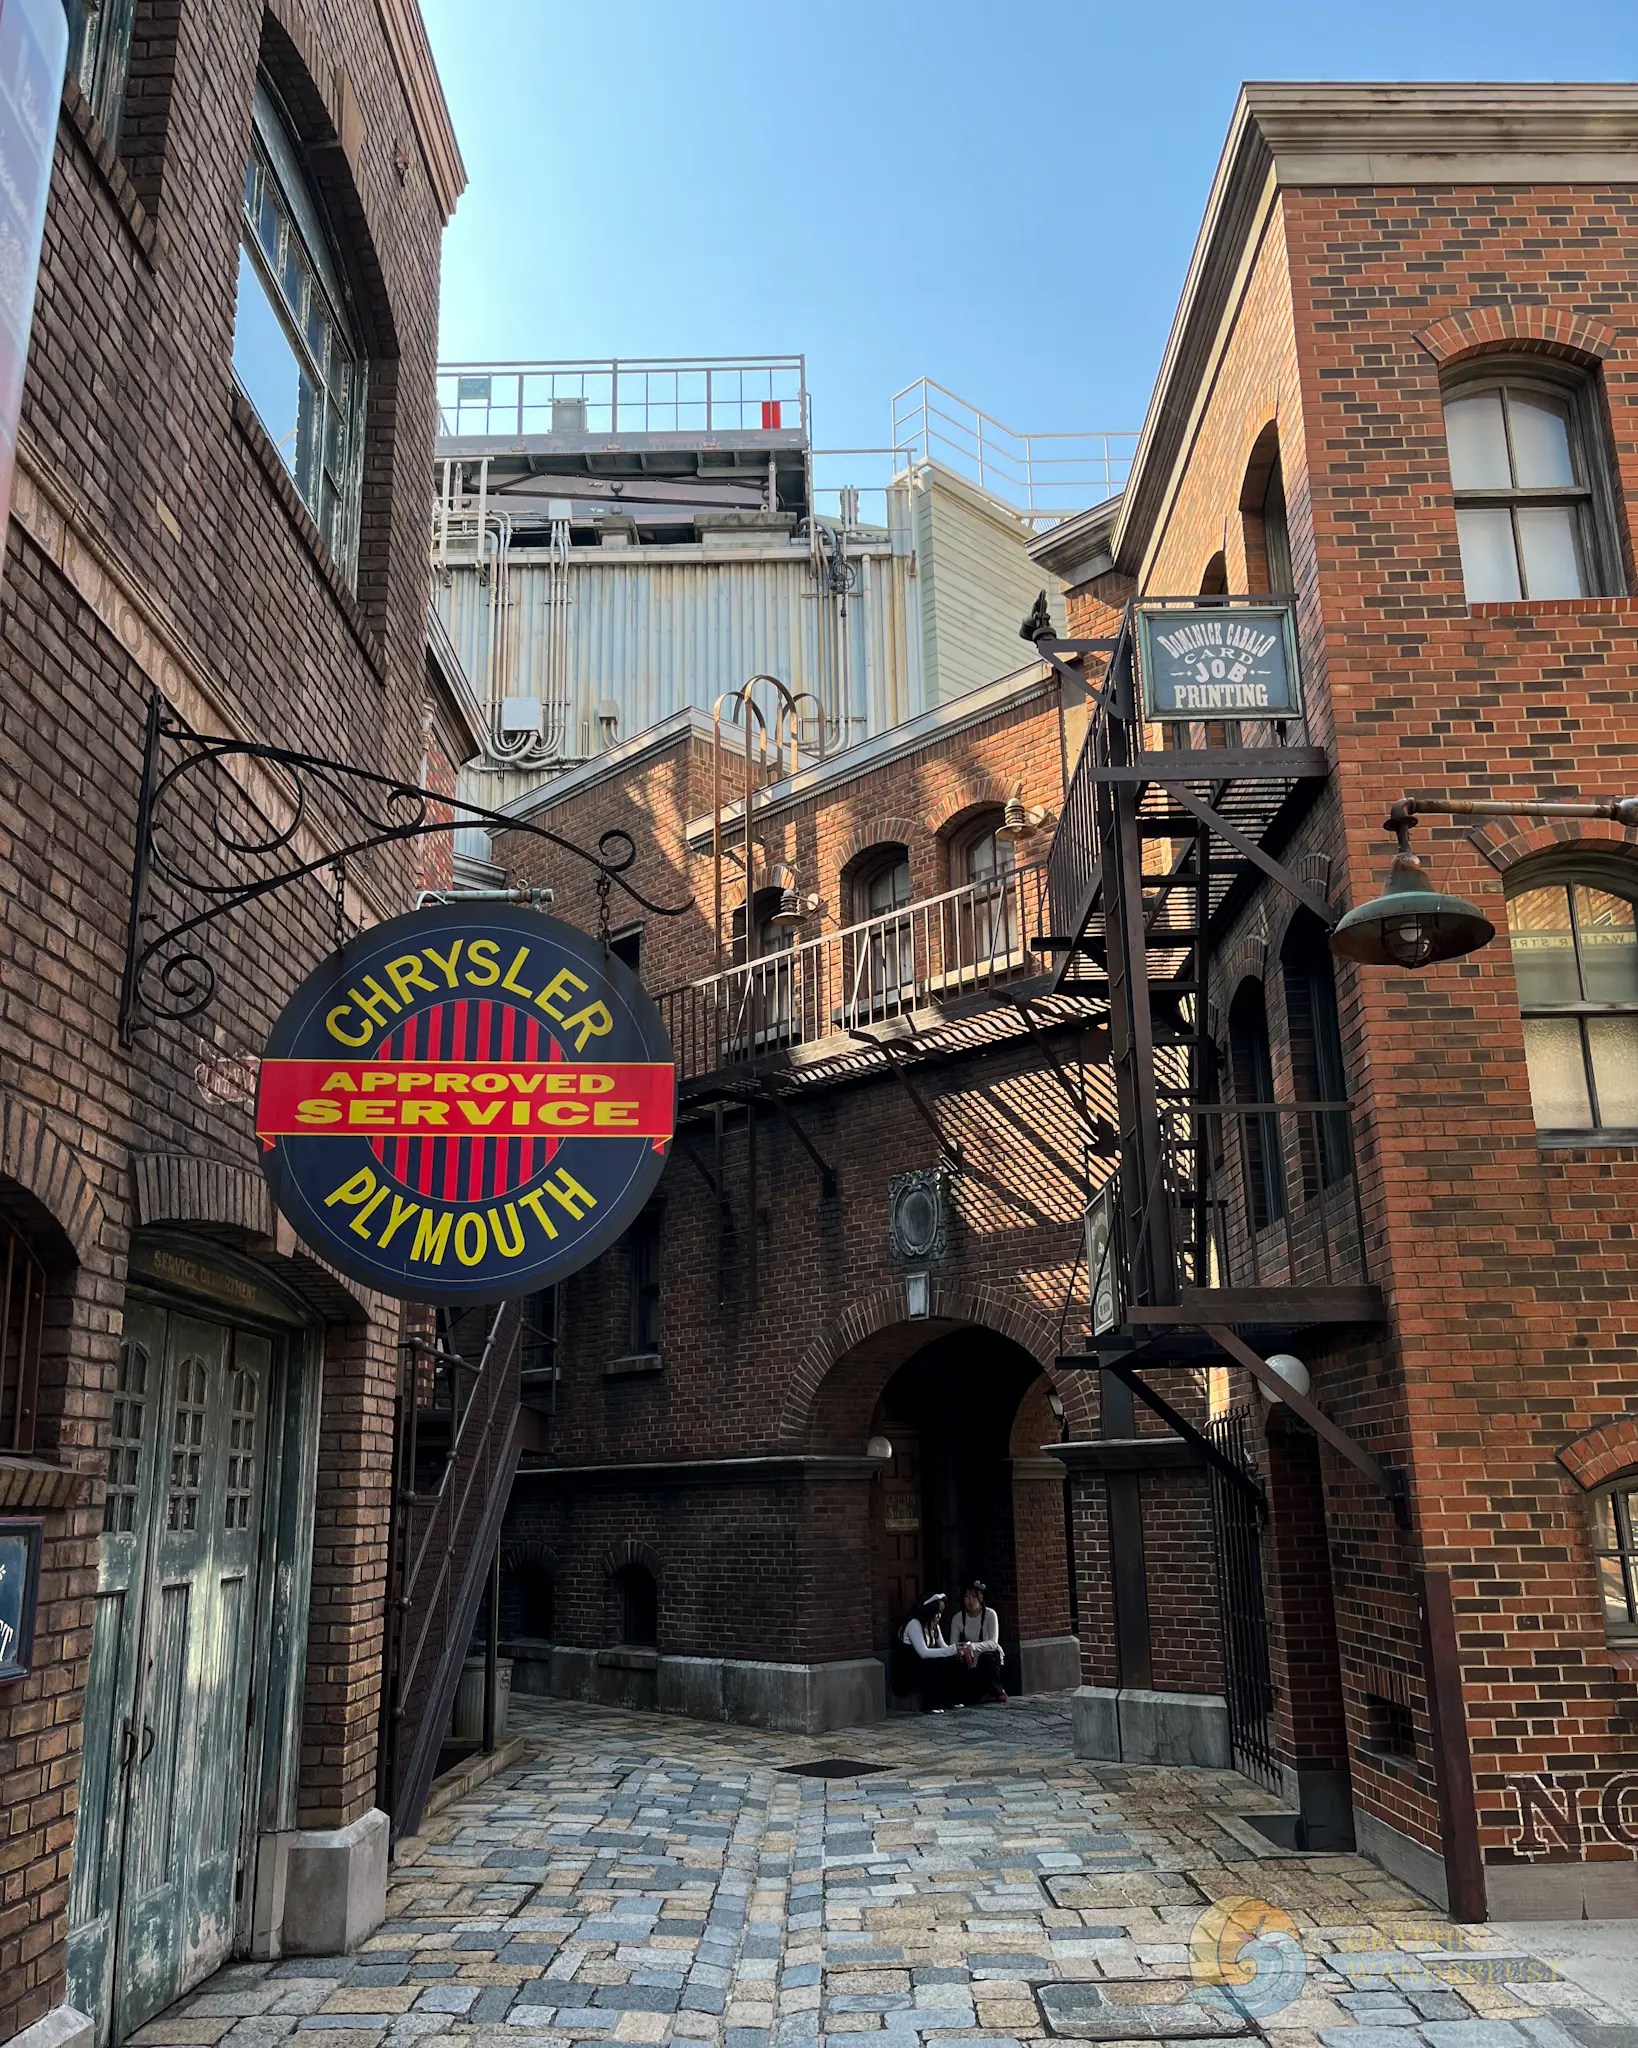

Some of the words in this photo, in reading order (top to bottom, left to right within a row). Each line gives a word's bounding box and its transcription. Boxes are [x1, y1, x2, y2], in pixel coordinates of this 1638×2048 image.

[94, 570, 200, 734] MOTOR
[1156, 622, 1223, 660] DOMINICK
[1184, 647, 1254, 665] CARD
[1195, 658, 1249, 683] JOB
[1173, 683, 1269, 709] PRINTING
[325, 938, 614, 1053] CHRYSLER
[320, 1071, 616, 1094] APPROVED
[294, 1098, 640, 1126] SERVICE
[323, 1165, 598, 1267] PLYMOUTH
[153, 1250, 197, 1282] SERVICE
[201, 1267, 257, 1301] DEPARTMENT
